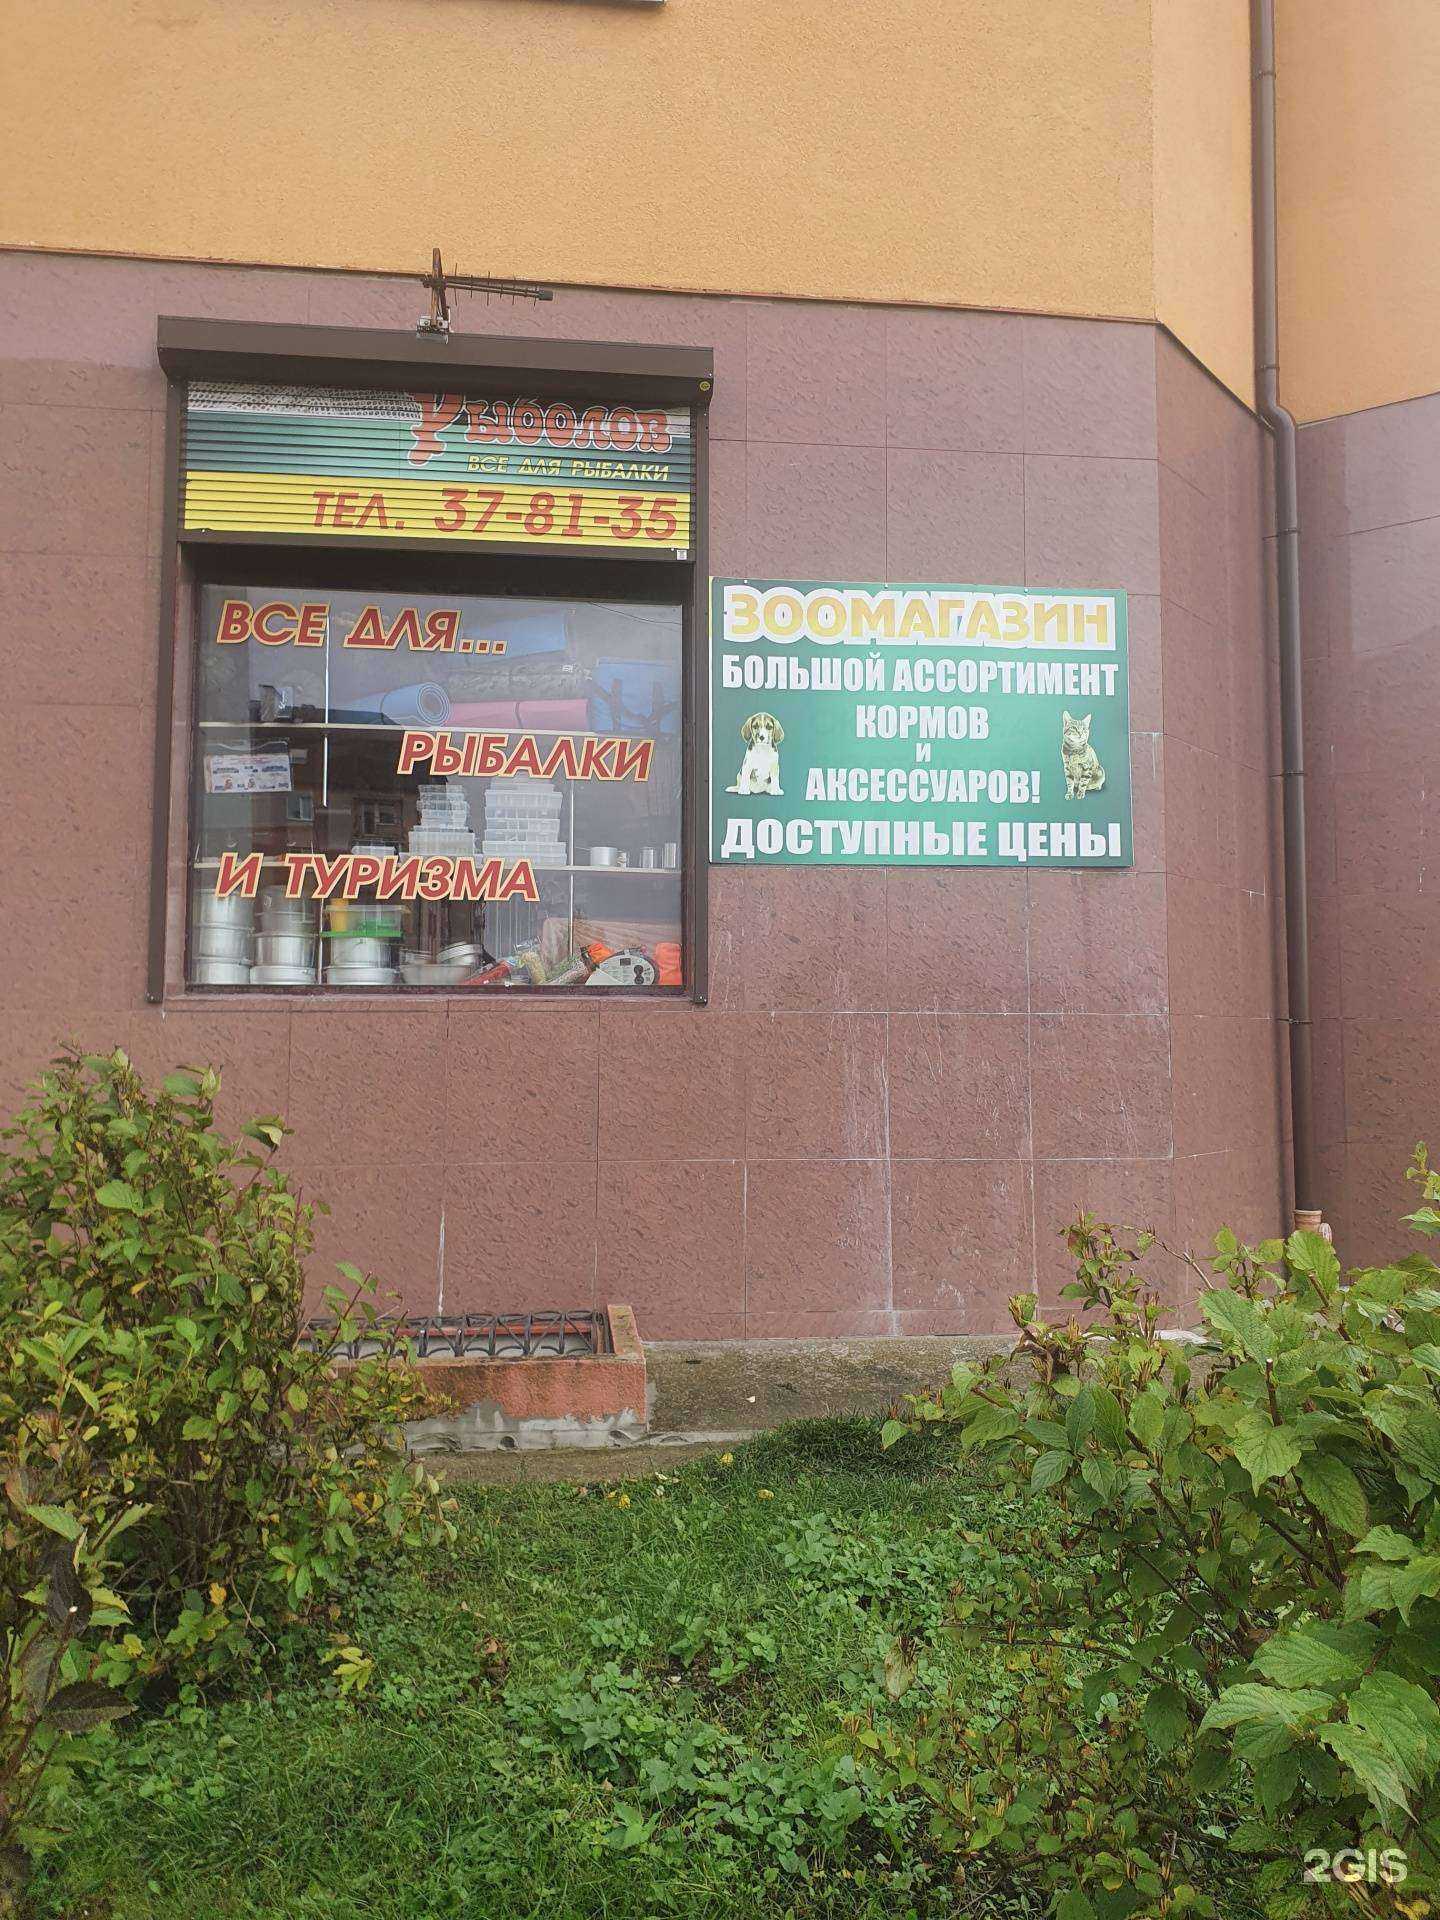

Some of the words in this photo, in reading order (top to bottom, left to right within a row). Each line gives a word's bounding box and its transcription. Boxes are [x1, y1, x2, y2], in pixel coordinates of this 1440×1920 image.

[467, 454, 510, 474] ВСЕ
[518, 457, 563, 477] ДЛЯ
[571, 459, 670, 481] РЫБАЛКИ
[312, 490, 405, 530] ТЕЛ.
[434, 488, 678, 540] 37-81-35
[217, 600, 331, 647] ВСЕ
[728, 590, 1112, 646] ЗООМАГАЗИН
[722, 651, 886, 692] БОЛЬШОЙ
[892, 658, 1119, 697] АССОРТИМЕНТ
[856, 704, 990, 740] КОРМОВ
[396, 731, 656, 782] РЫБАЛКИ
[805, 767, 1041, 804] АКСЕССУАРОВ!
[721, 818, 988, 860] ДОСТУПНЫЕ
[998, 821, 1121, 862] ЦЕНЫ
[215, 851, 264, 899] И
[283, 853, 541, 902] ТУРИЗМА
